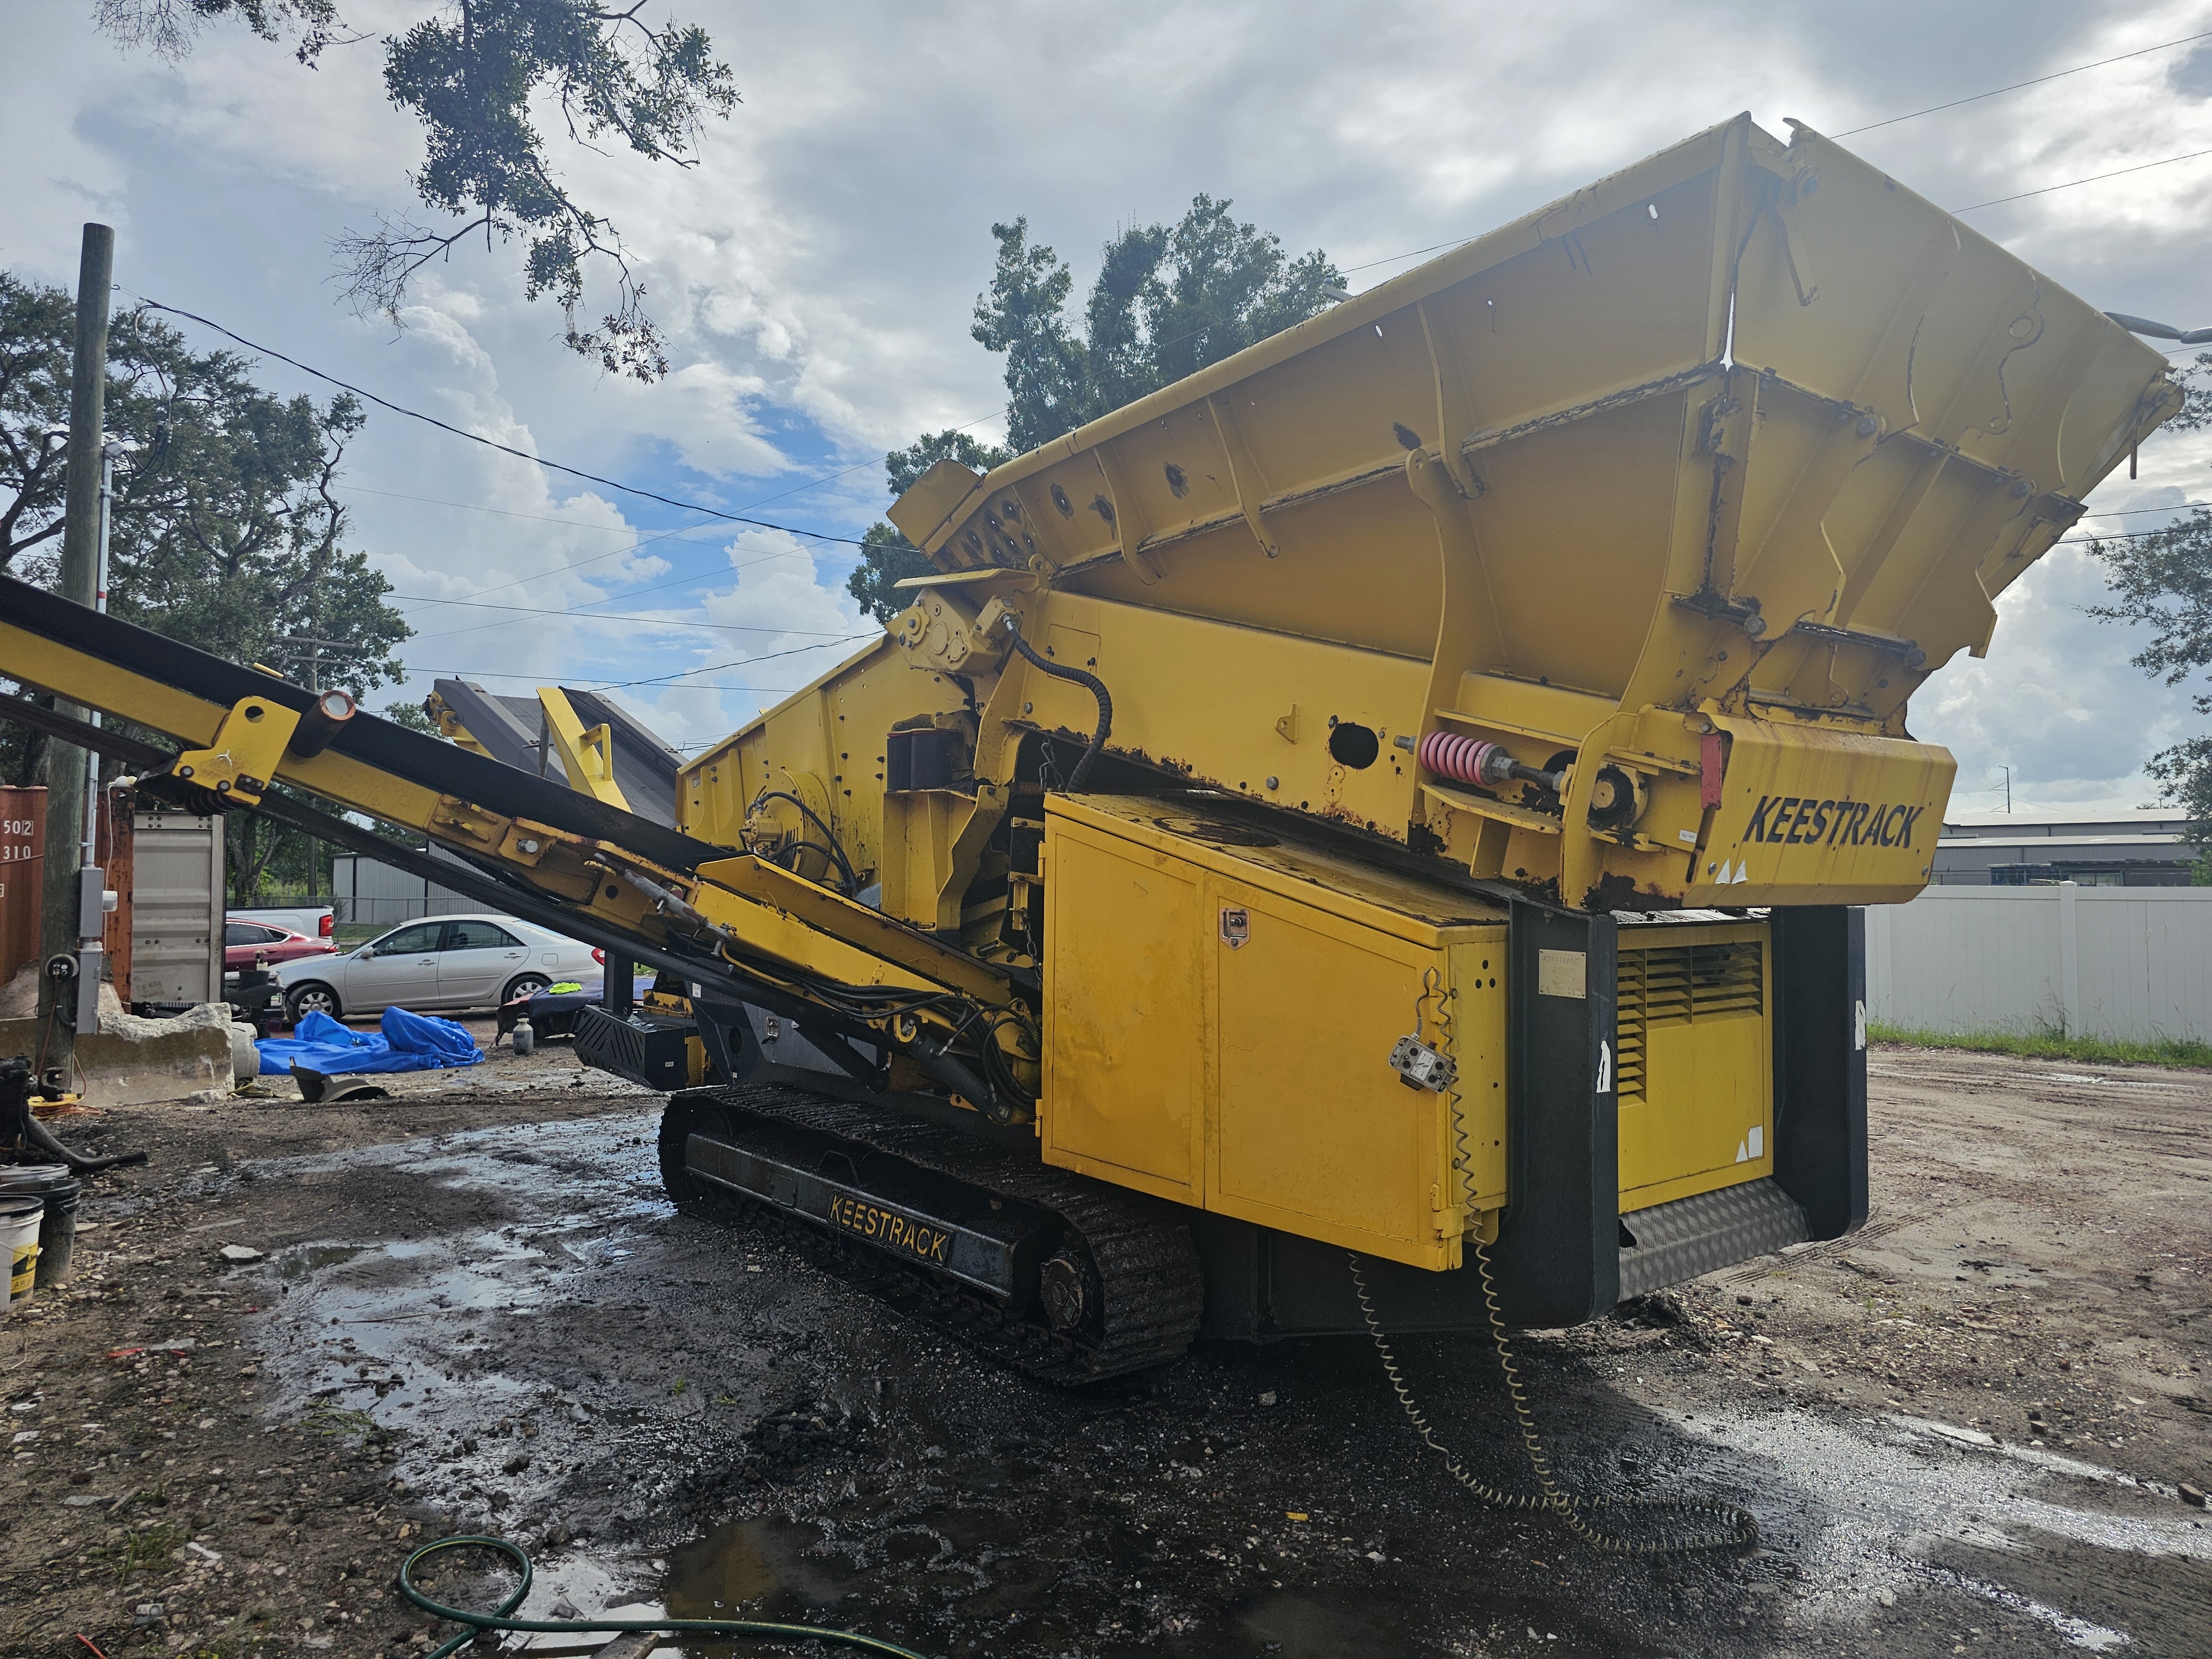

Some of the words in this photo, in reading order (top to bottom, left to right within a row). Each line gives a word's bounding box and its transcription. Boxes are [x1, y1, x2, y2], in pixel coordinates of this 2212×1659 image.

[3, 820, 32, 834] 502
[1743, 795, 1924, 849] KEESTRACK
[3, 846, 31, 859] 310
[830, 1195, 947, 1262] KEESTRACK
[14, 1279, 27, 1288] AW
